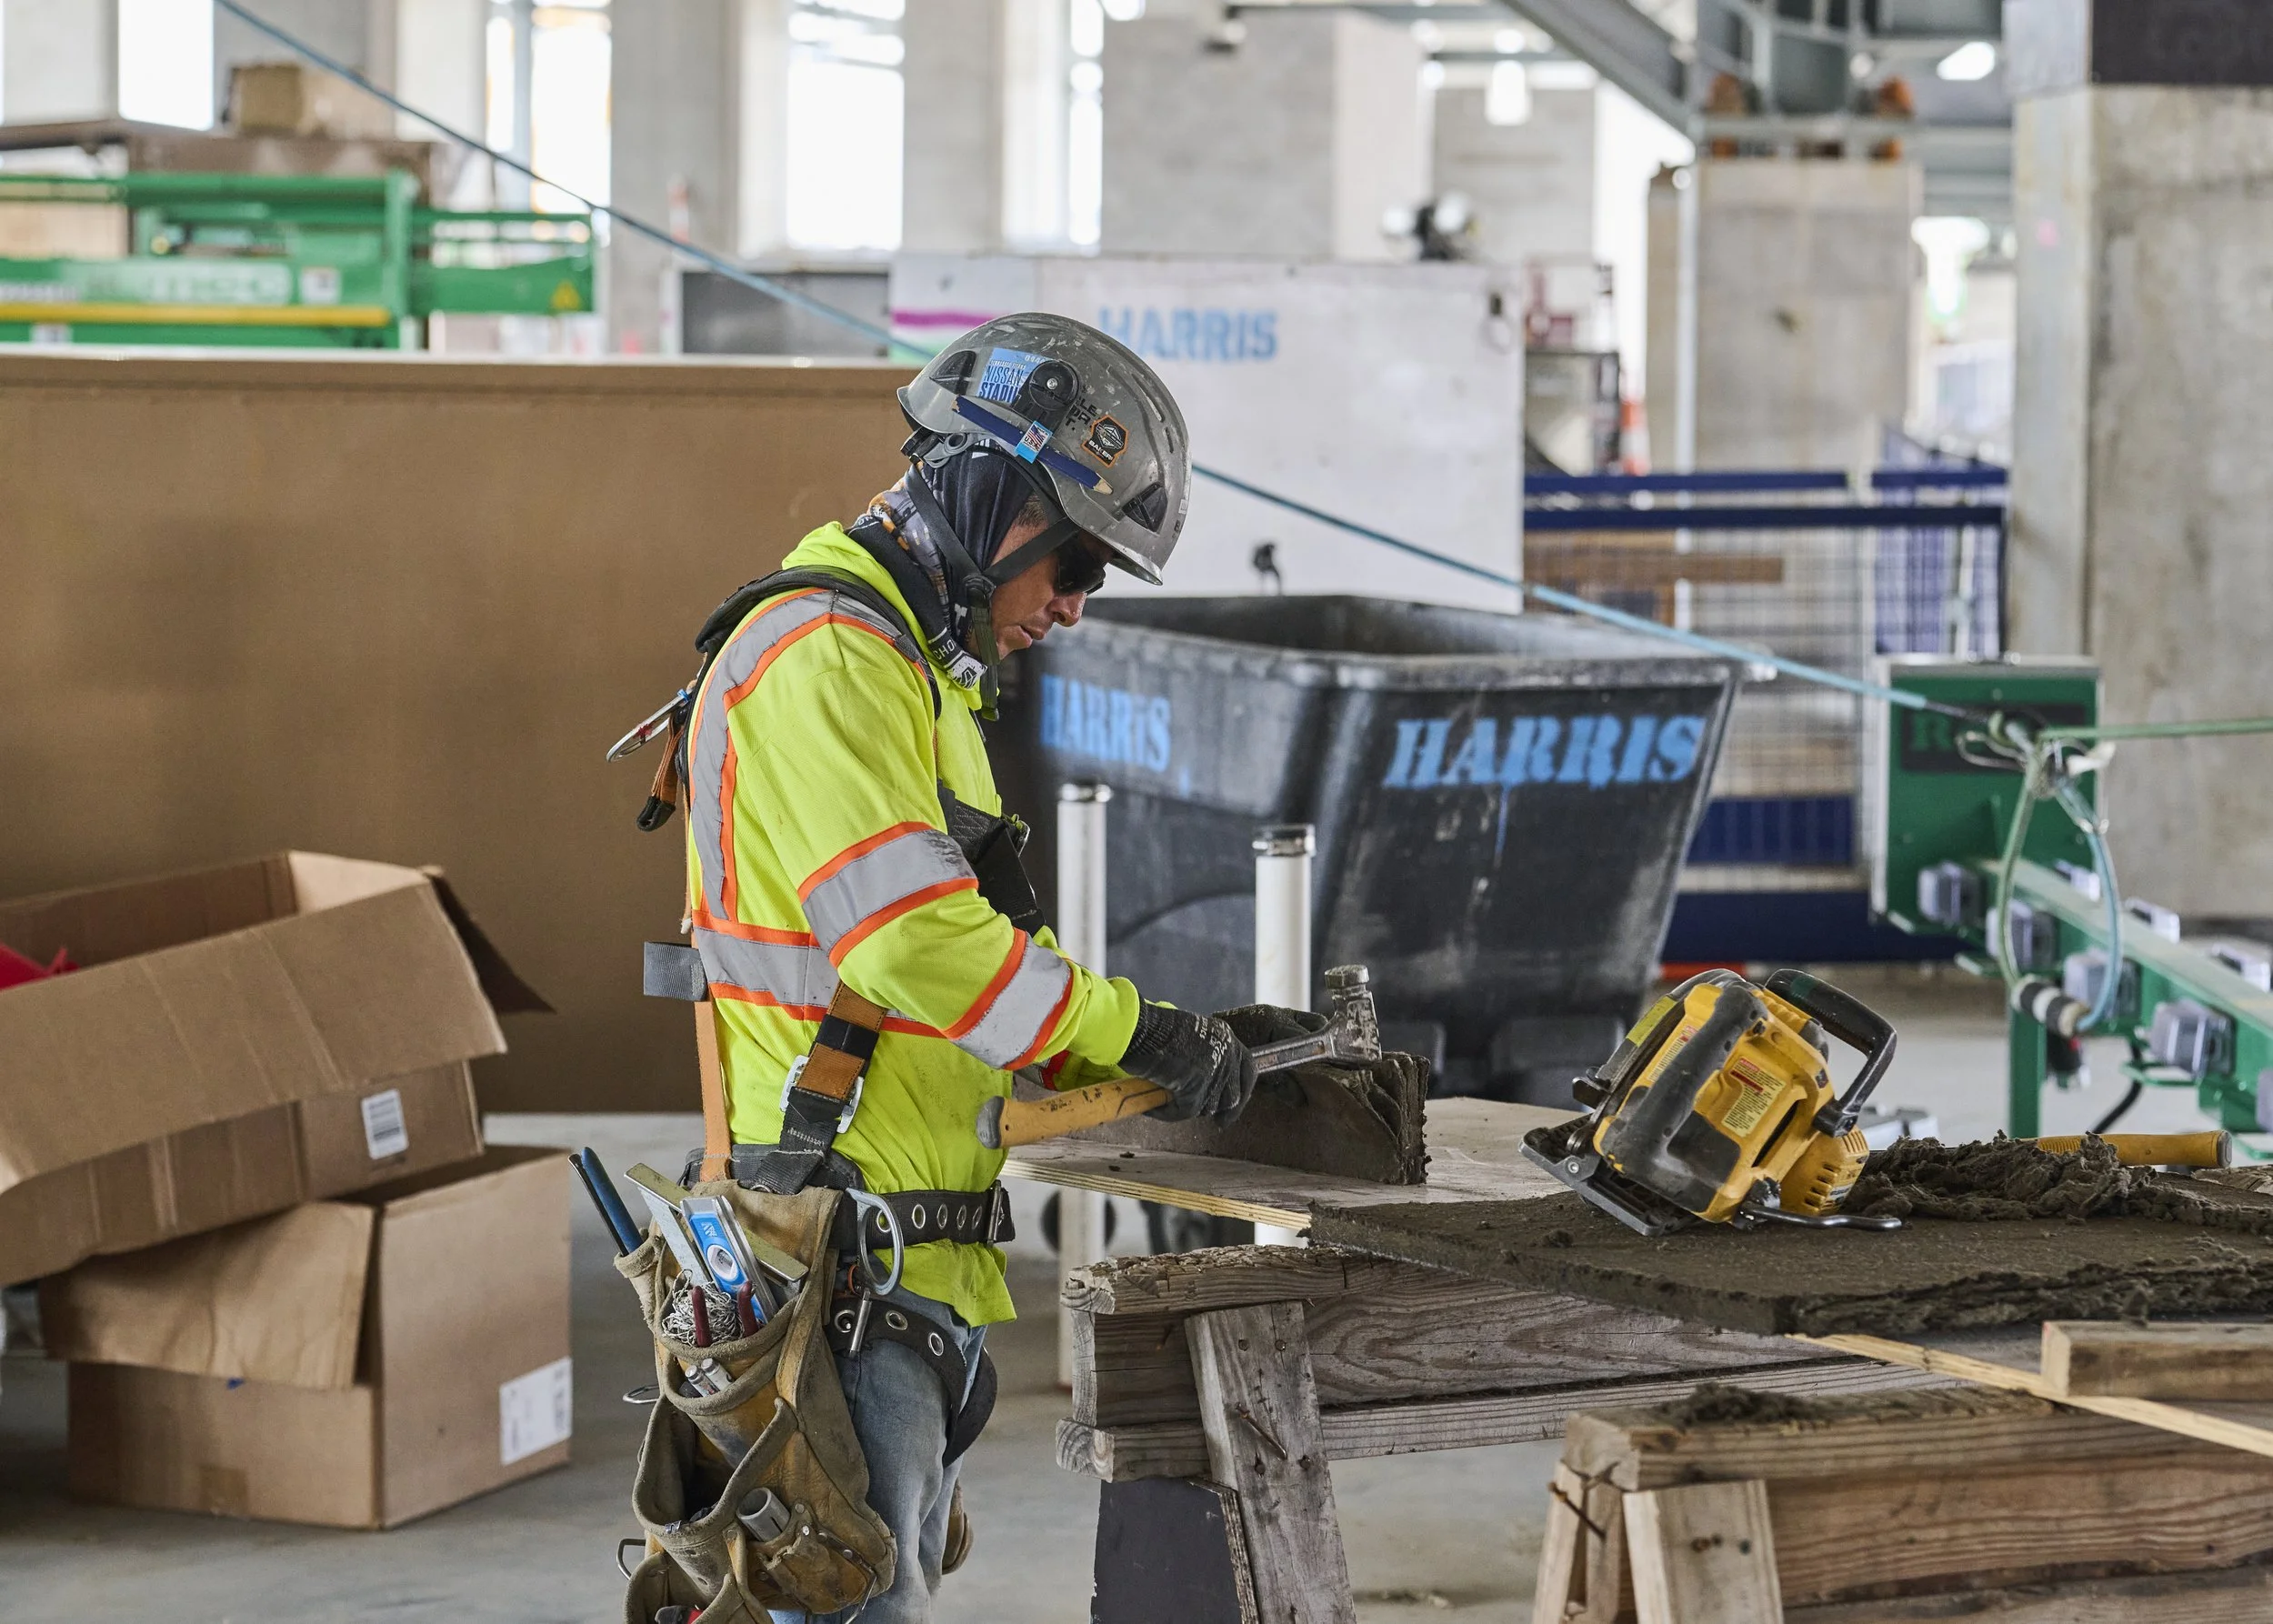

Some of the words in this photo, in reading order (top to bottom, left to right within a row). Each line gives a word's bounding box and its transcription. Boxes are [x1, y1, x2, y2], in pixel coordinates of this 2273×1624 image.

[1097, 305, 1280, 363] HARRIS
[984, 364, 1025, 386] NISSAN
[1040, 672, 1171, 772] HARRIS
[1381, 714, 1707, 790] HARRIS
